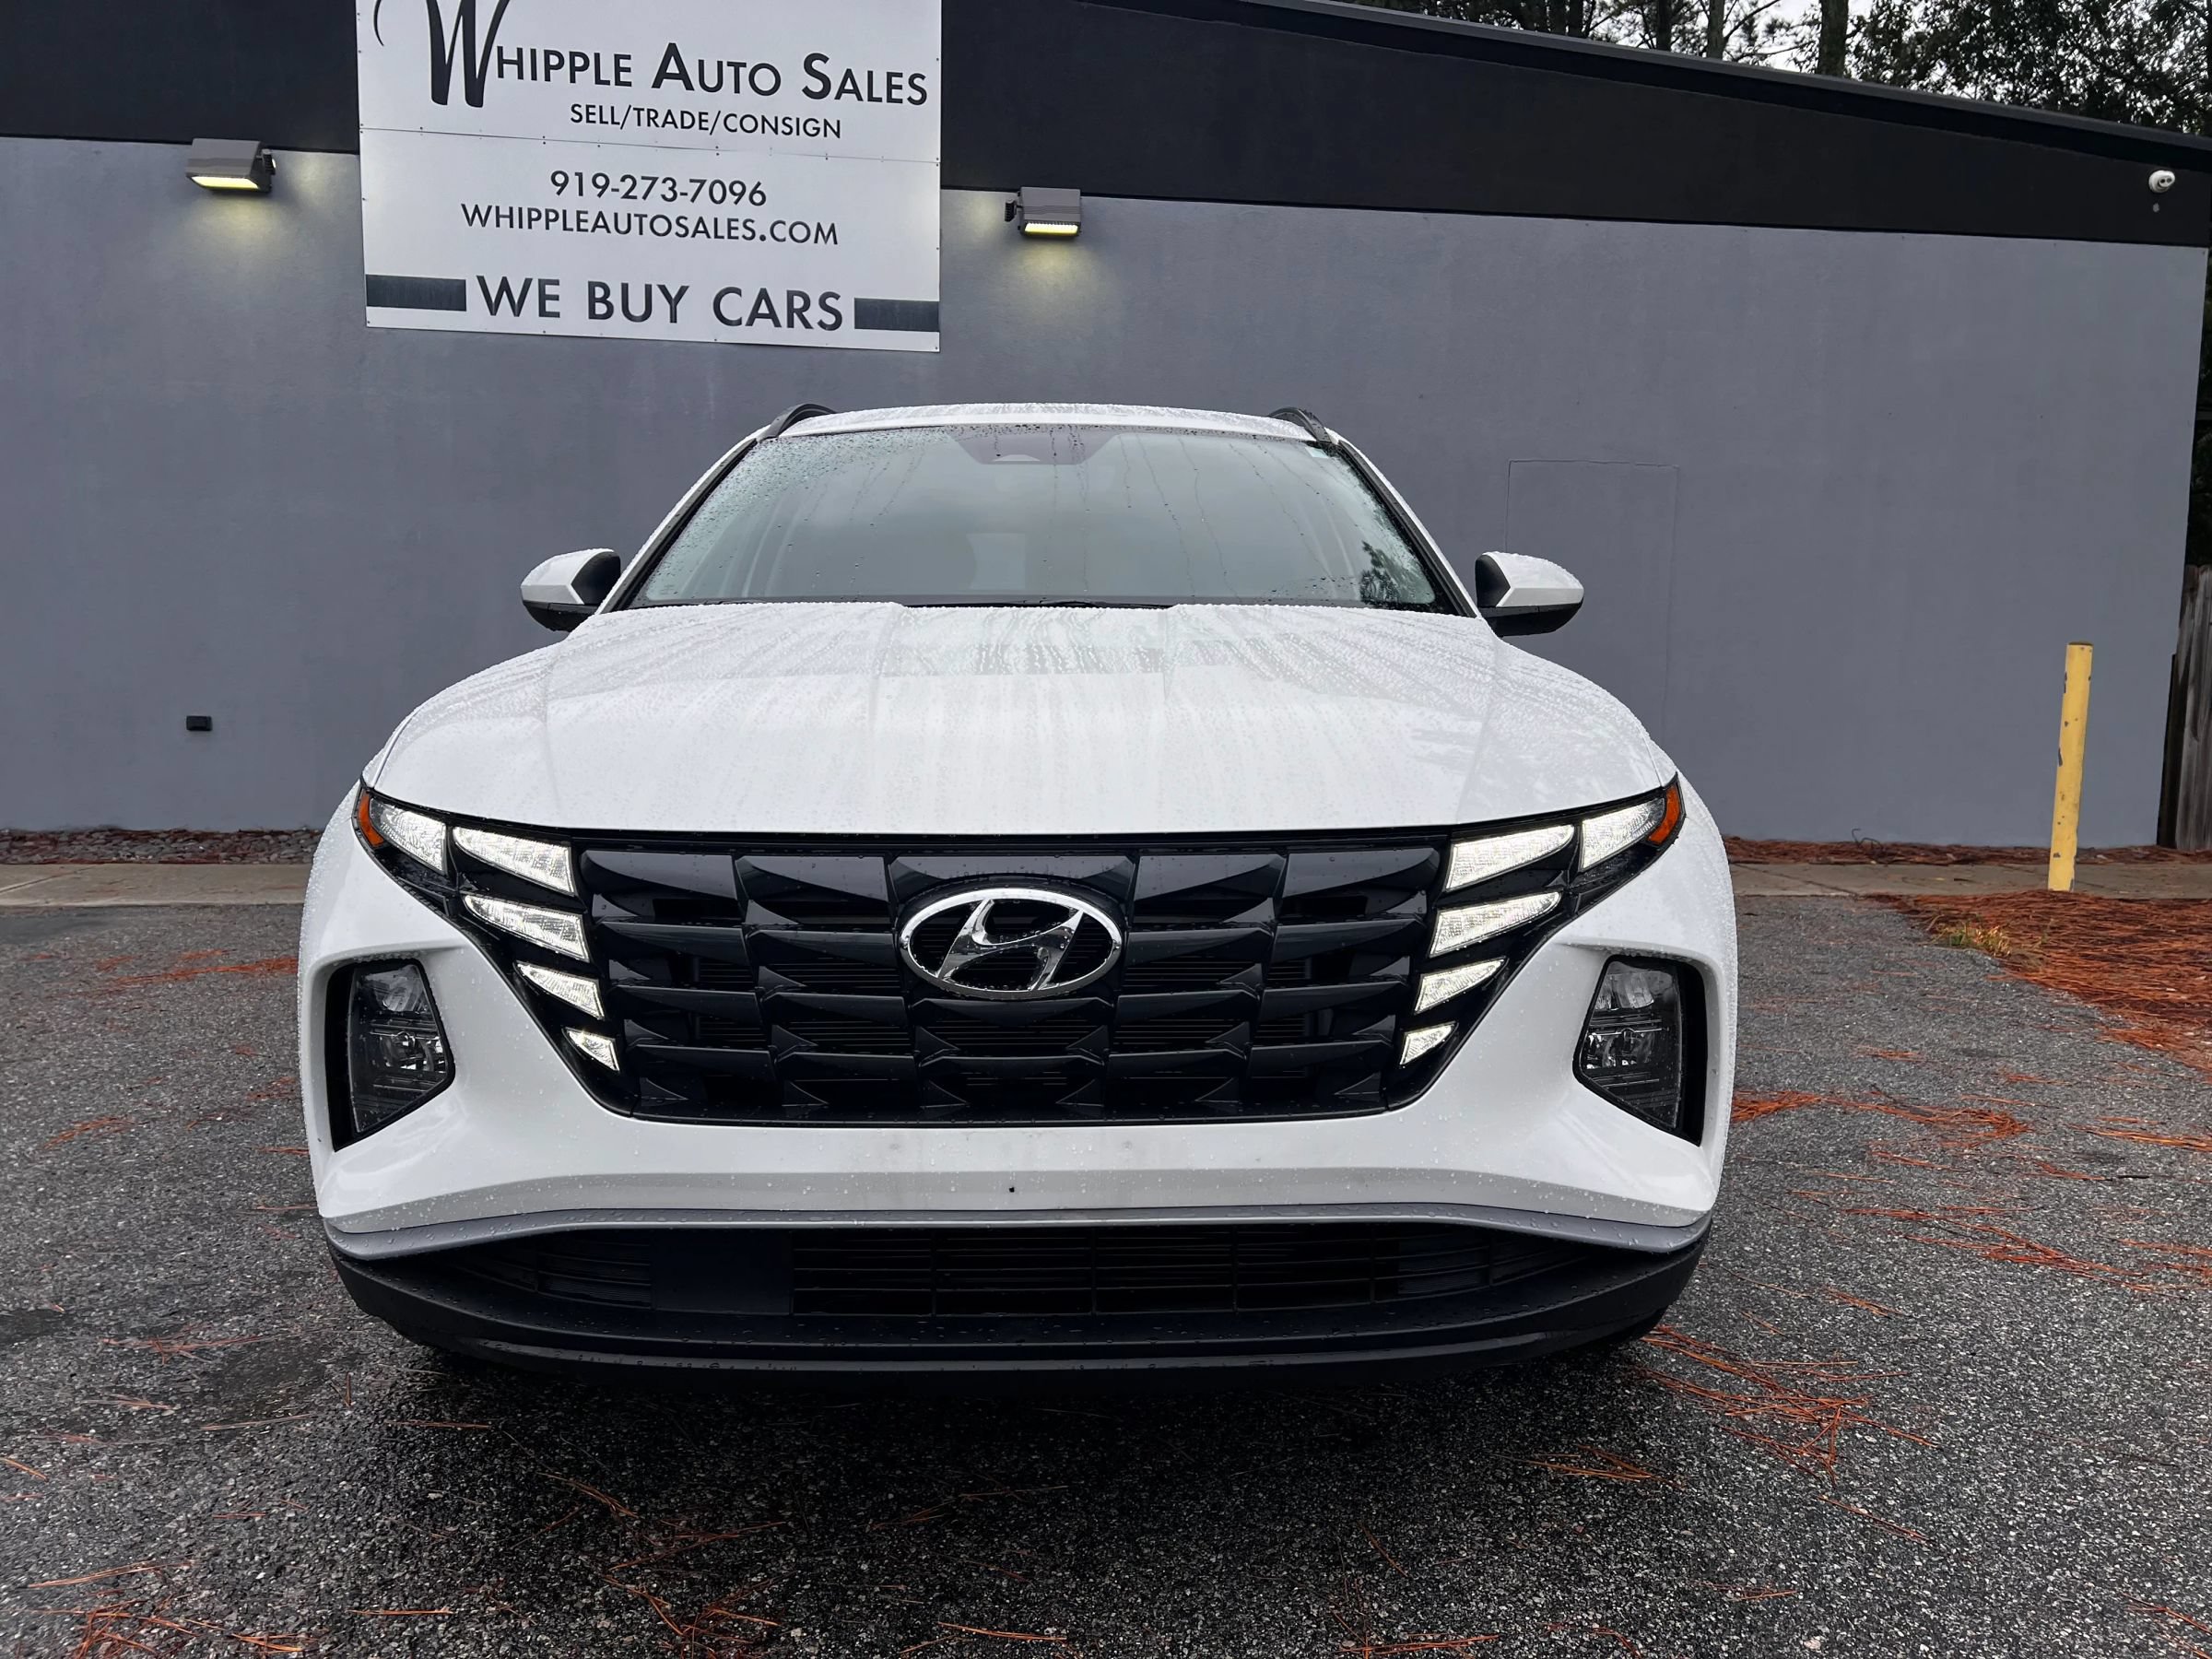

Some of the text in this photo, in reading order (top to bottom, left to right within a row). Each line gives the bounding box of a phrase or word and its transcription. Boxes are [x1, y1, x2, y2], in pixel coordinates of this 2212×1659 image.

[651, 41, 782, 97] AUTO
[801, 53, 928, 106] SALES
[570, 103, 841, 139] SELL/TRADE/CONSIGN
[550, 170, 767, 206] 919-273-7096
[460, 203, 839, 245] WHIPPLEAUTOSALES.COM
[476, 275, 843, 332] WE BUY CARS
